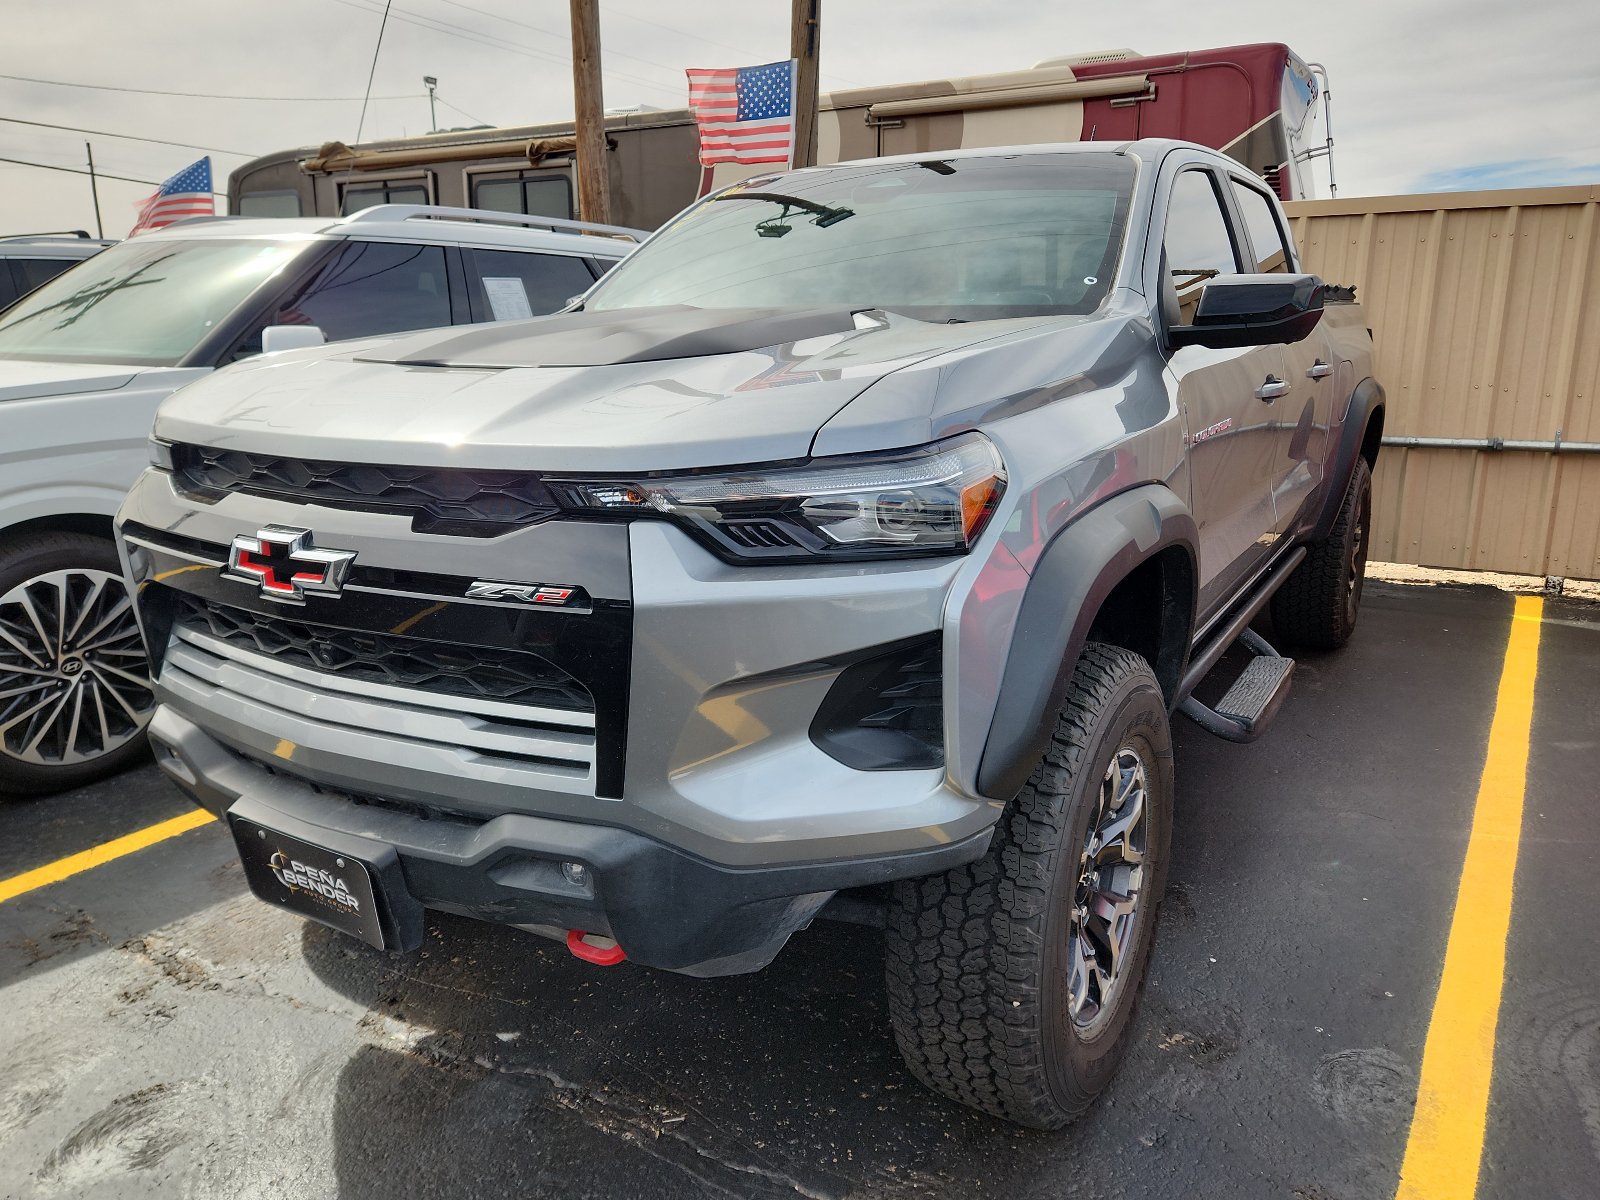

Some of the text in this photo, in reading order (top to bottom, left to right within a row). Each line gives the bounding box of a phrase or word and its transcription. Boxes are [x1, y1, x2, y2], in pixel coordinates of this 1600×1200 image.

[464, 581, 573, 605] ZR2
[282, 869, 360, 911] BENDER
[290, 860, 349, 894] PEÑA
